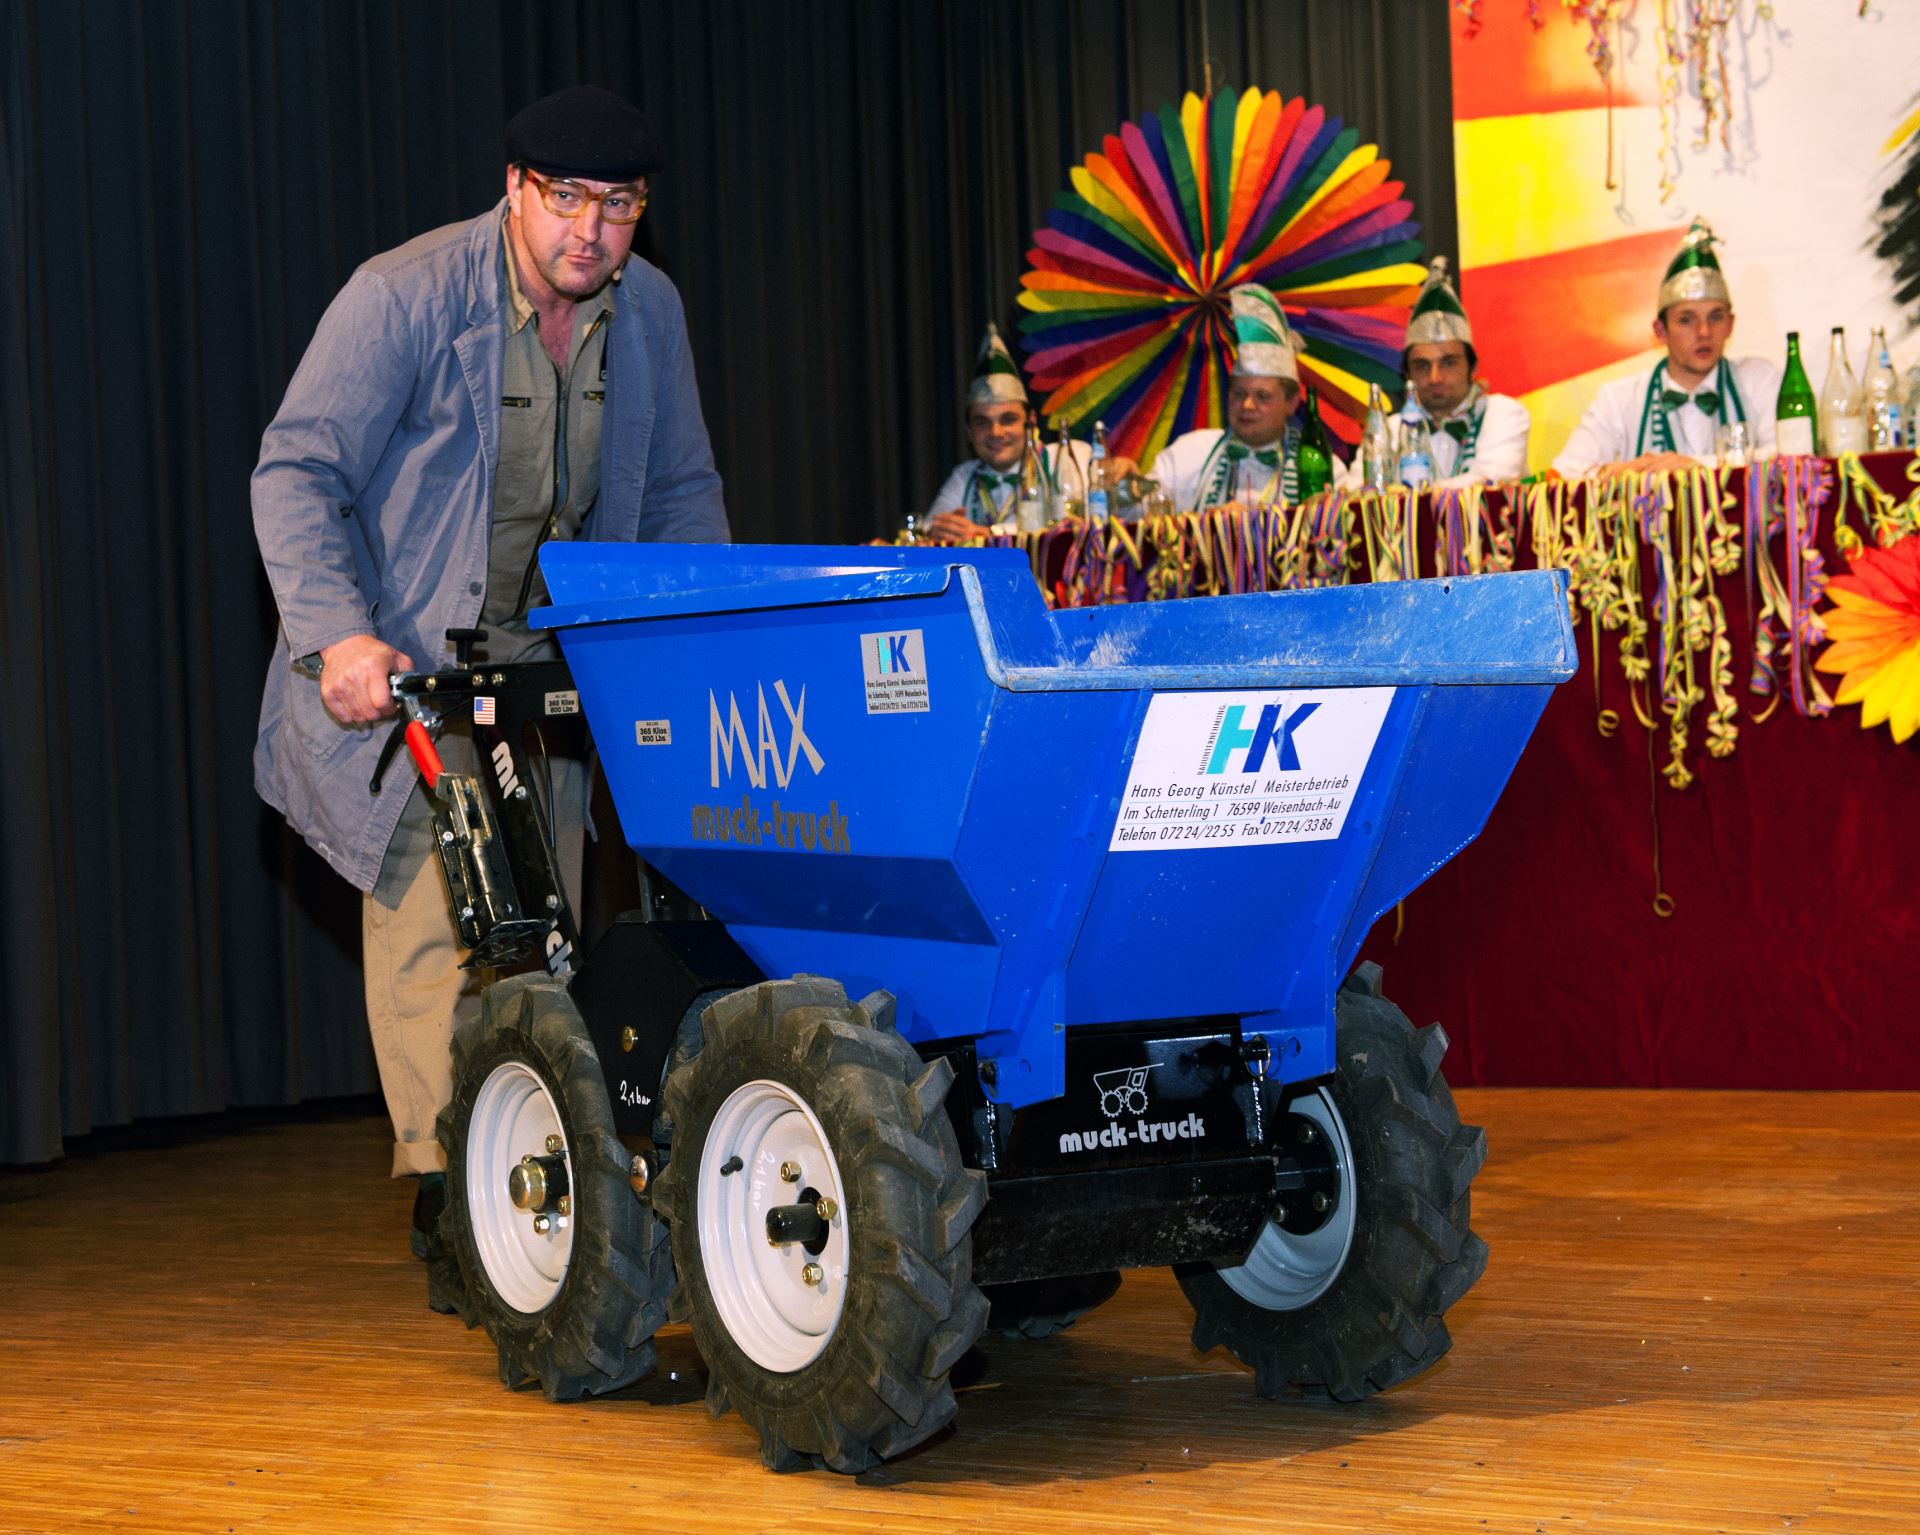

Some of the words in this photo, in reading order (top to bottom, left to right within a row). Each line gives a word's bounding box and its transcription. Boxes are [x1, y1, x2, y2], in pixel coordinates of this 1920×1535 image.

[652, 727, 667, 735] Kilos
[655, 734, 666, 742] Lbs
[709, 679, 825, 792] MAX
[1206, 702, 1324, 775] HK
[1131, 784, 1162, 798] Hans
[1168, 782, 1205, 799] Georg
[1210, 780, 1257, 797] Künstel
[1264, 774, 1350, 794] Meisterbetrieb
[1123, 806, 1139, 820] Im
[1143, 803, 1211, 821] Schetterling
[1227, 801, 1261, 817] 76599
[1262, 798, 1343, 815] Weisenbach-Au
[691, 794, 851, 856] muck-truck
[1118, 827, 1157, 843] Telefon
[1241, 821, 1261, 837] Fax
[1059, 1112, 1206, 1154] muck-truck
